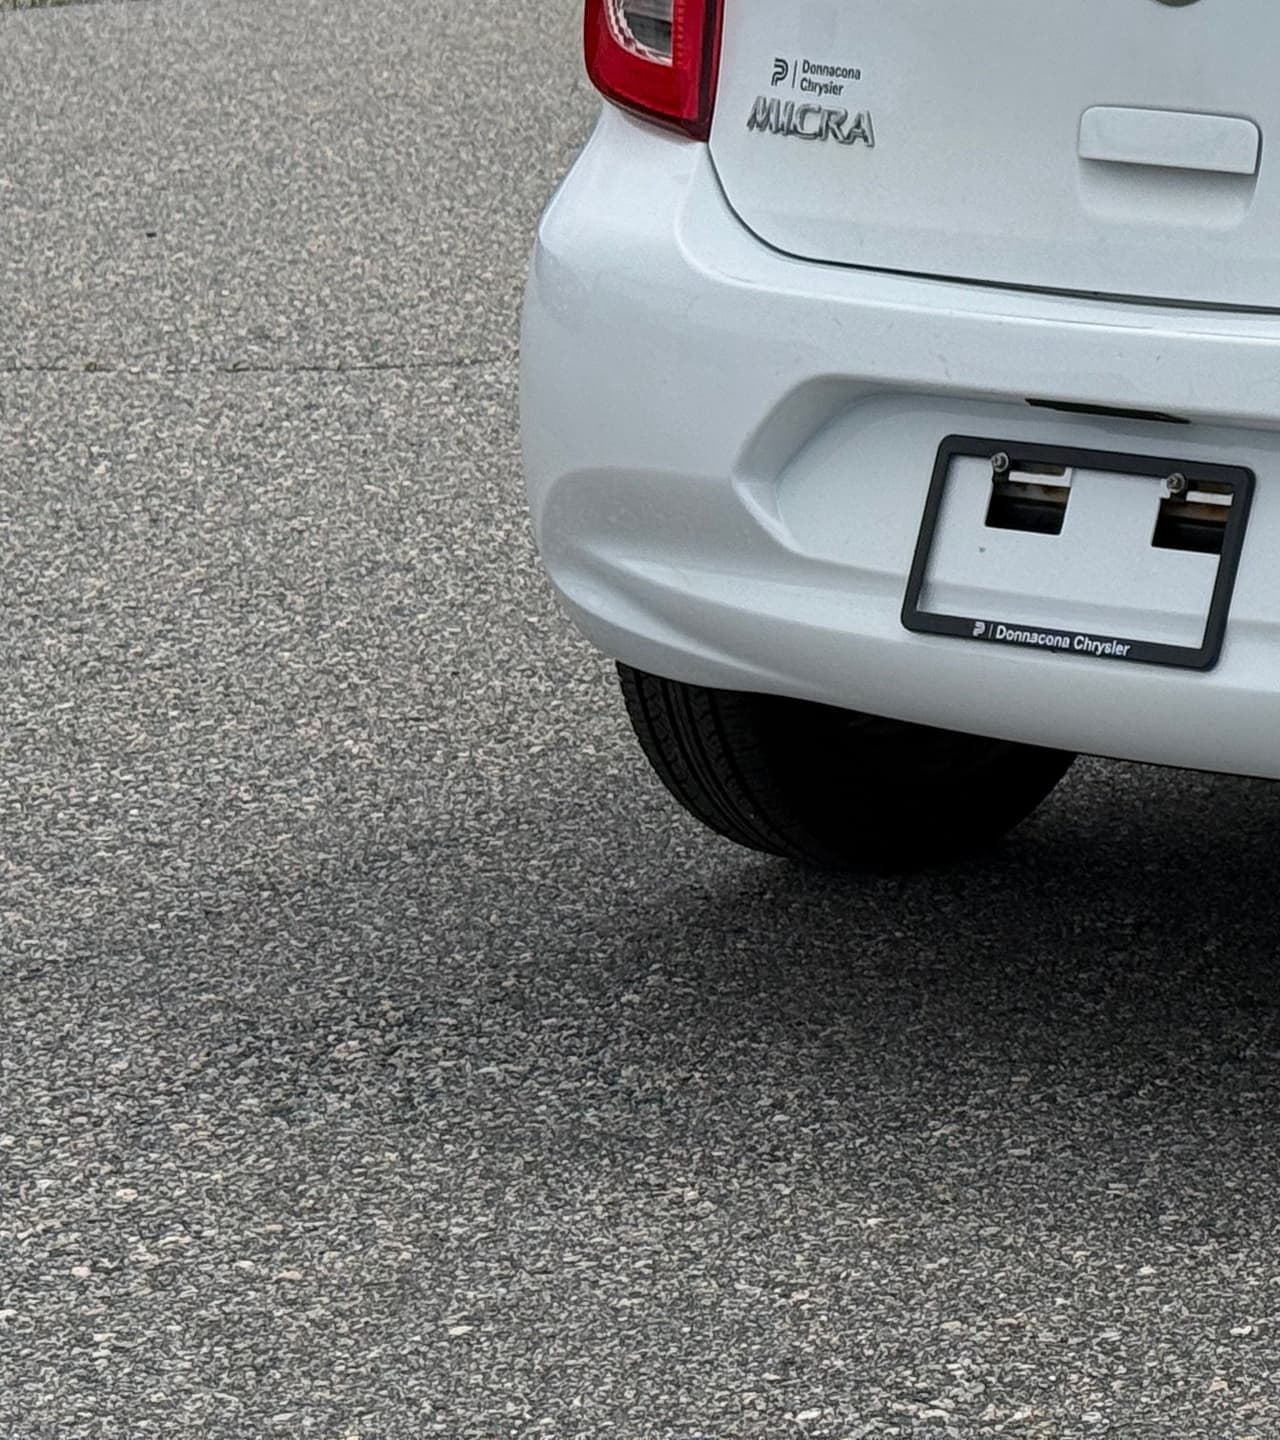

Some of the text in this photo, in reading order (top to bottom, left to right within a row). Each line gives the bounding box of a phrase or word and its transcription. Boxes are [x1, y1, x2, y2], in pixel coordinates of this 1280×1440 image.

[801, 59, 862, 81] Donnacona
[799, 77, 845, 97] Chrysler
[746, 95, 876, 148] MICRA
[995, 625, 1071, 649] Donnacona
[1073, 635, 1132, 657] Chrysler
